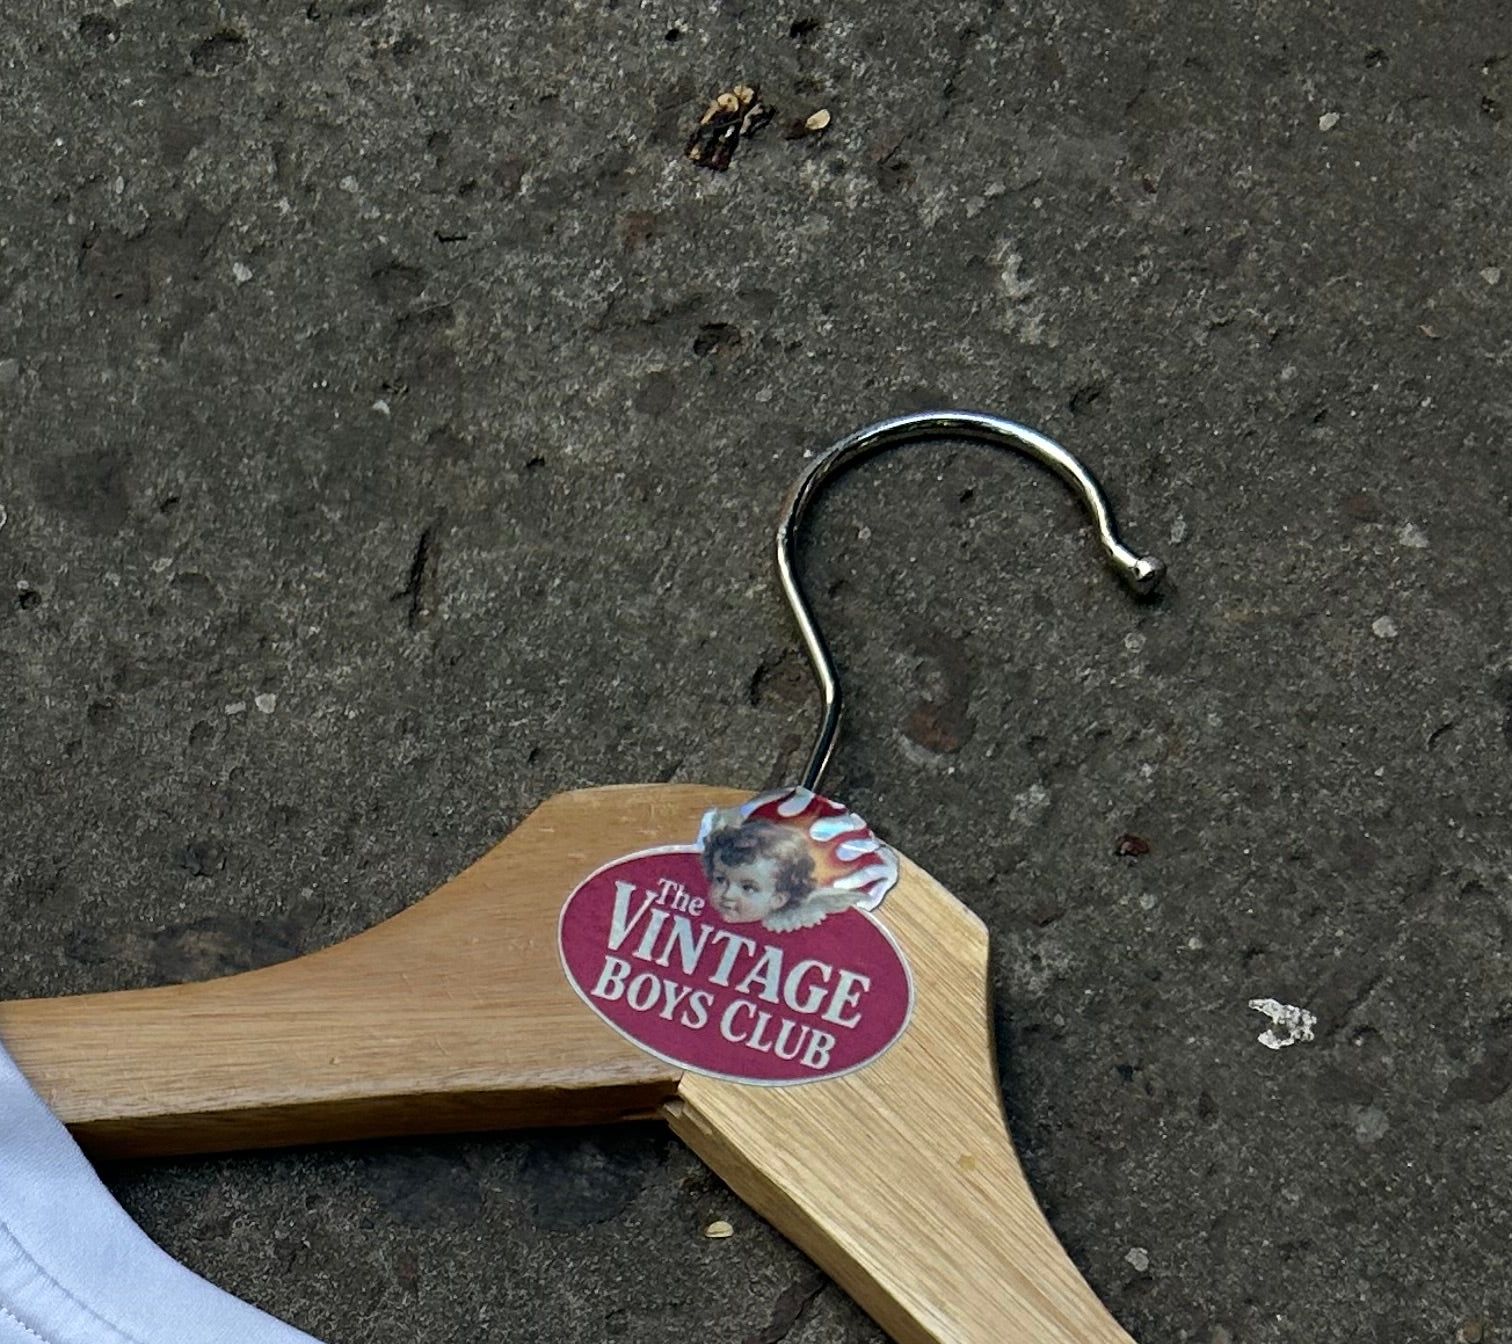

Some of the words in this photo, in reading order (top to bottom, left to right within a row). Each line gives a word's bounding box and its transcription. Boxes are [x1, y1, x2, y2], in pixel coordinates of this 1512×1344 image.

[606, 880, 871, 1029] VINTAGE
[658, 878, 706, 917] The
[591, 955, 715, 1030] BOYS
[720, 1000, 836, 1071] CLUB
